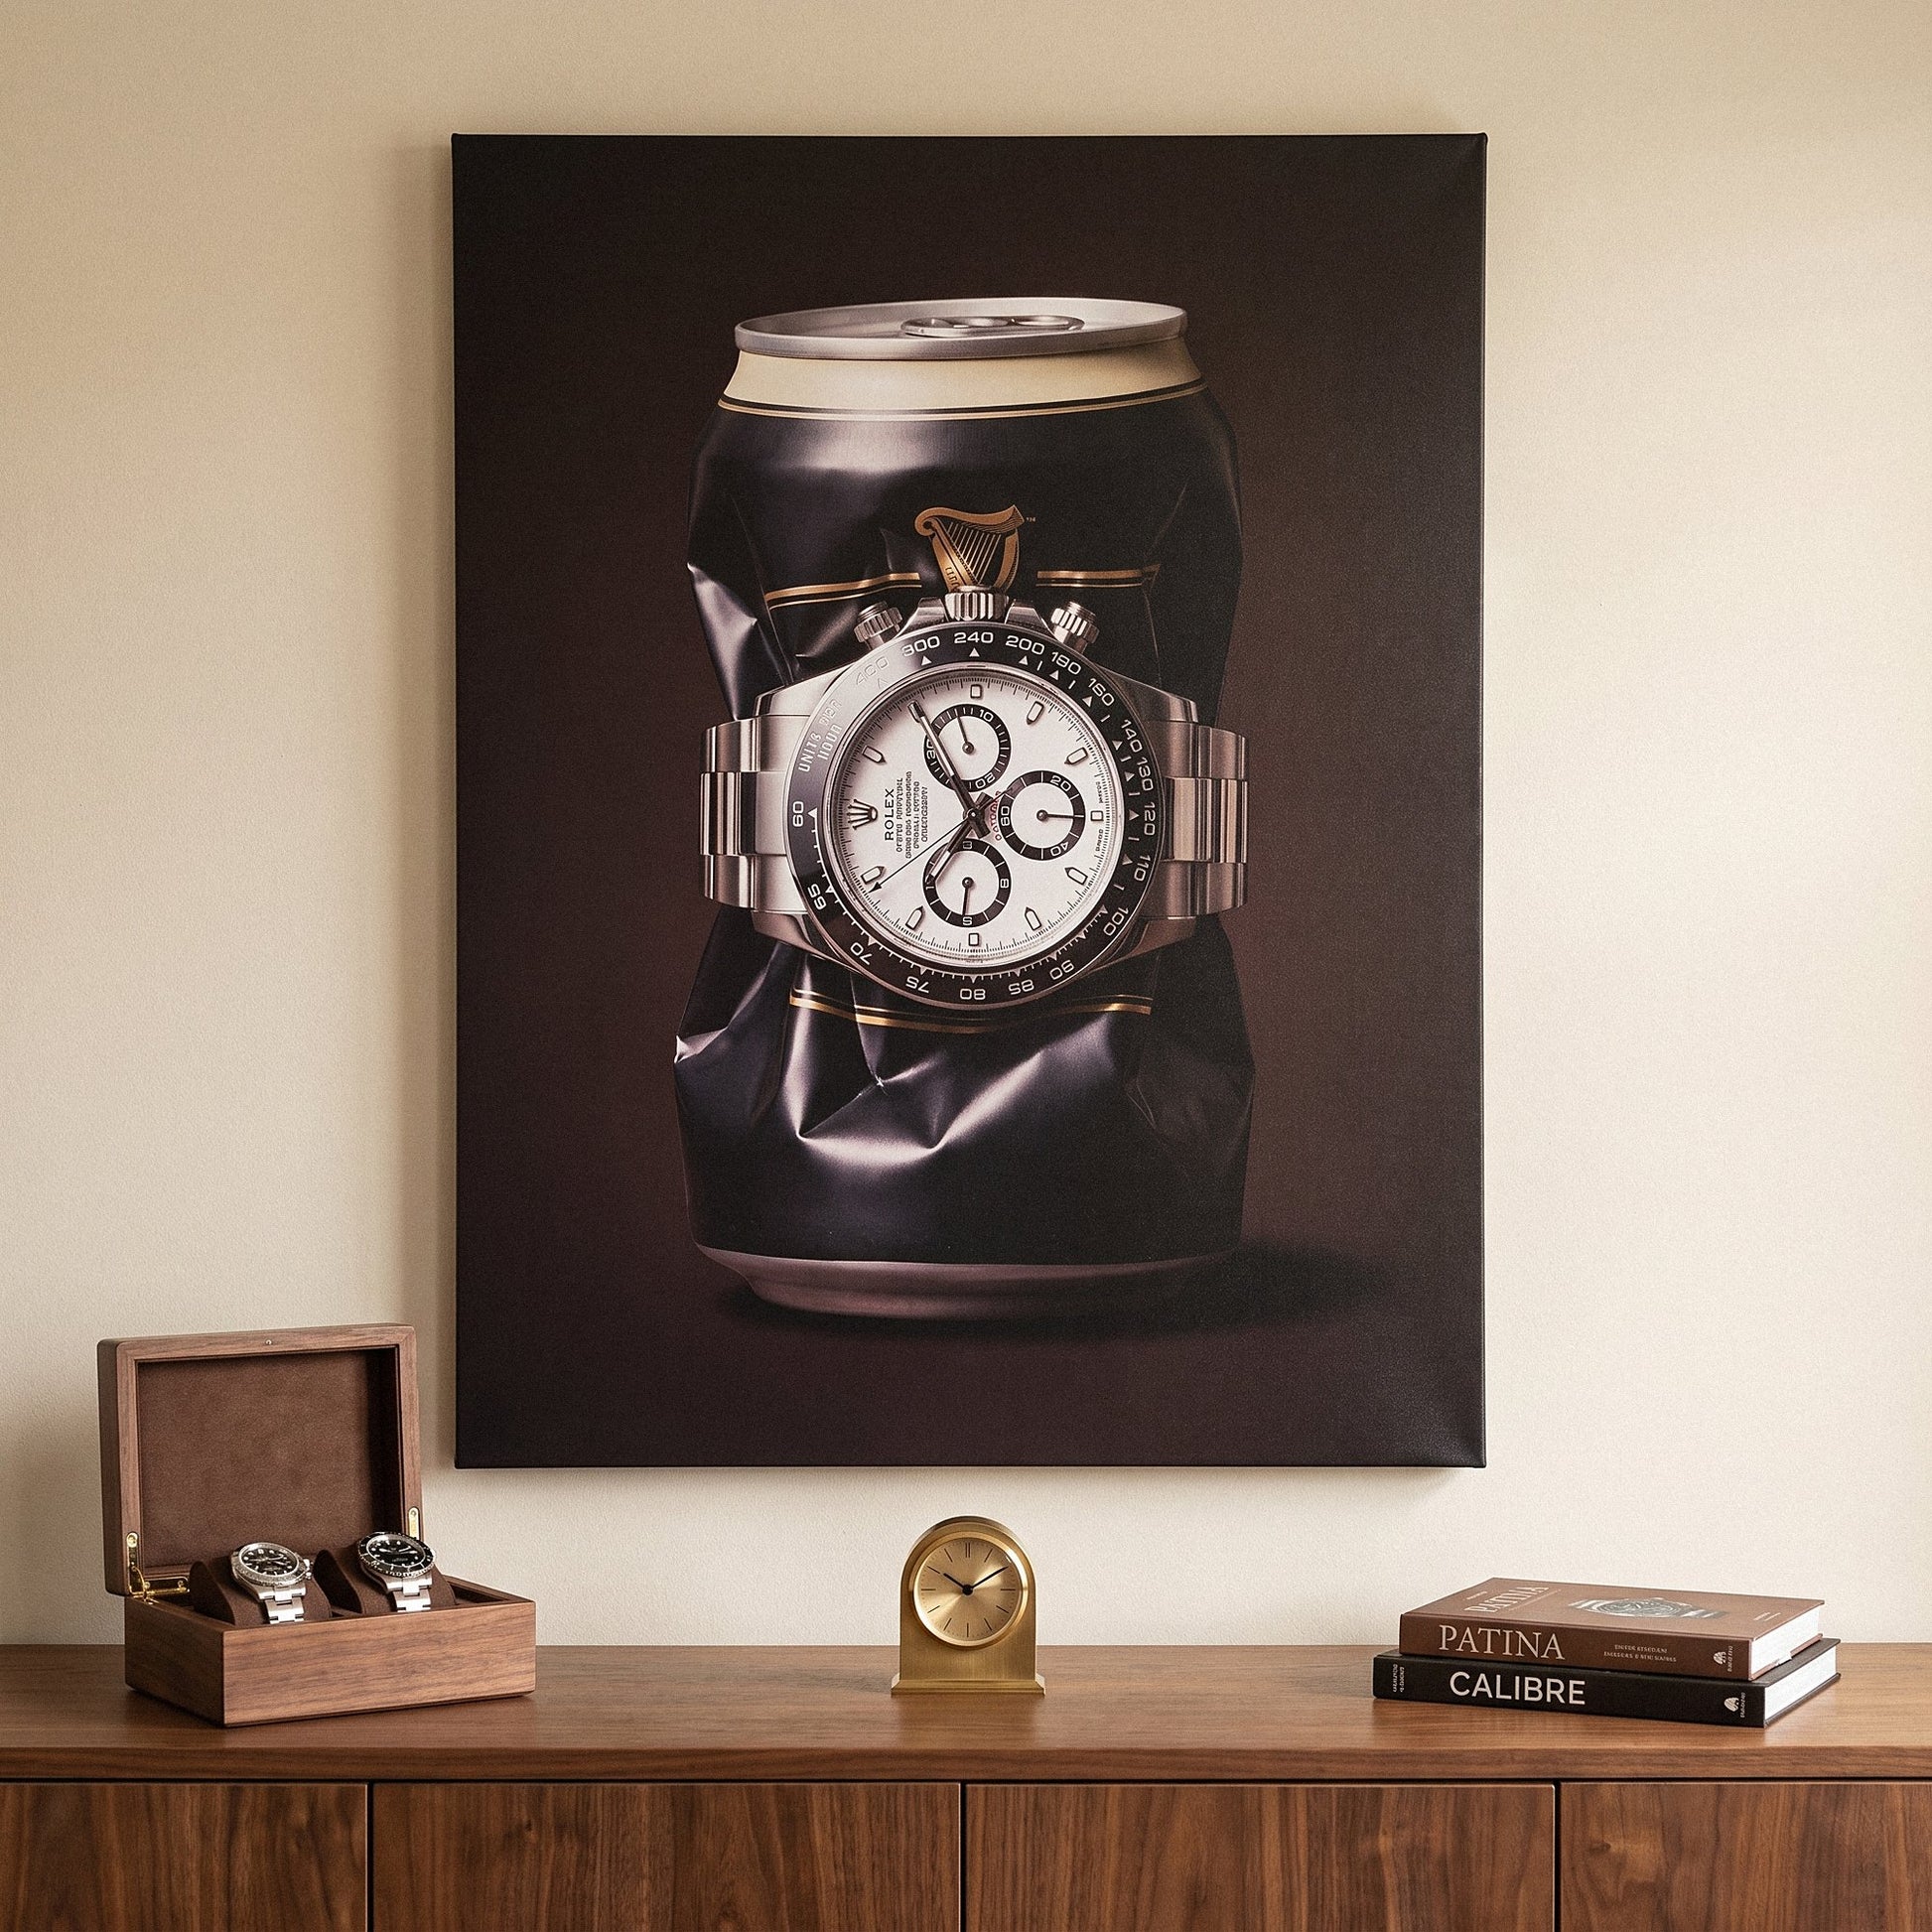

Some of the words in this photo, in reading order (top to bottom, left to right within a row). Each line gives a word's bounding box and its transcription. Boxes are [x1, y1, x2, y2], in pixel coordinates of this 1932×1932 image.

[900, 635, 940, 656] 300
[953, 631, 994, 644] 240
[1005, 635, 1045, 655] 200
[1050, 651, 1082, 675] 180
[1087, 677, 1115, 707] 160
[979, 709, 995, 723] 10
[1121, 719, 1143, 753] 140
[975, 771, 996, 789] 20
[1049, 774, 1072, 792] 20
[1137, 757, 1155, 792] 130
[792, 800, 804, 827] 60
[884, 787, 895, 841] ROLEX
[1144, 801, 1157, 836] 120
[1049, 841, 1069, 857] 40
[1134, 855, 1152, 882] 110
[807, 883, 827, 910] 65
[1103, 905, 1131, 936] 100
[850, 941, 874, 966] 70
[1049, 959, 1075, 981] 90
[905, 976, 930, 994] 75
[959, 988, 986, 1001] 80
[1008, 979, 1035, 996] 85
[1439, 1624, 1566, 1660] PATINA
[1449, 1671, 1586, 1705] CALIBRE
